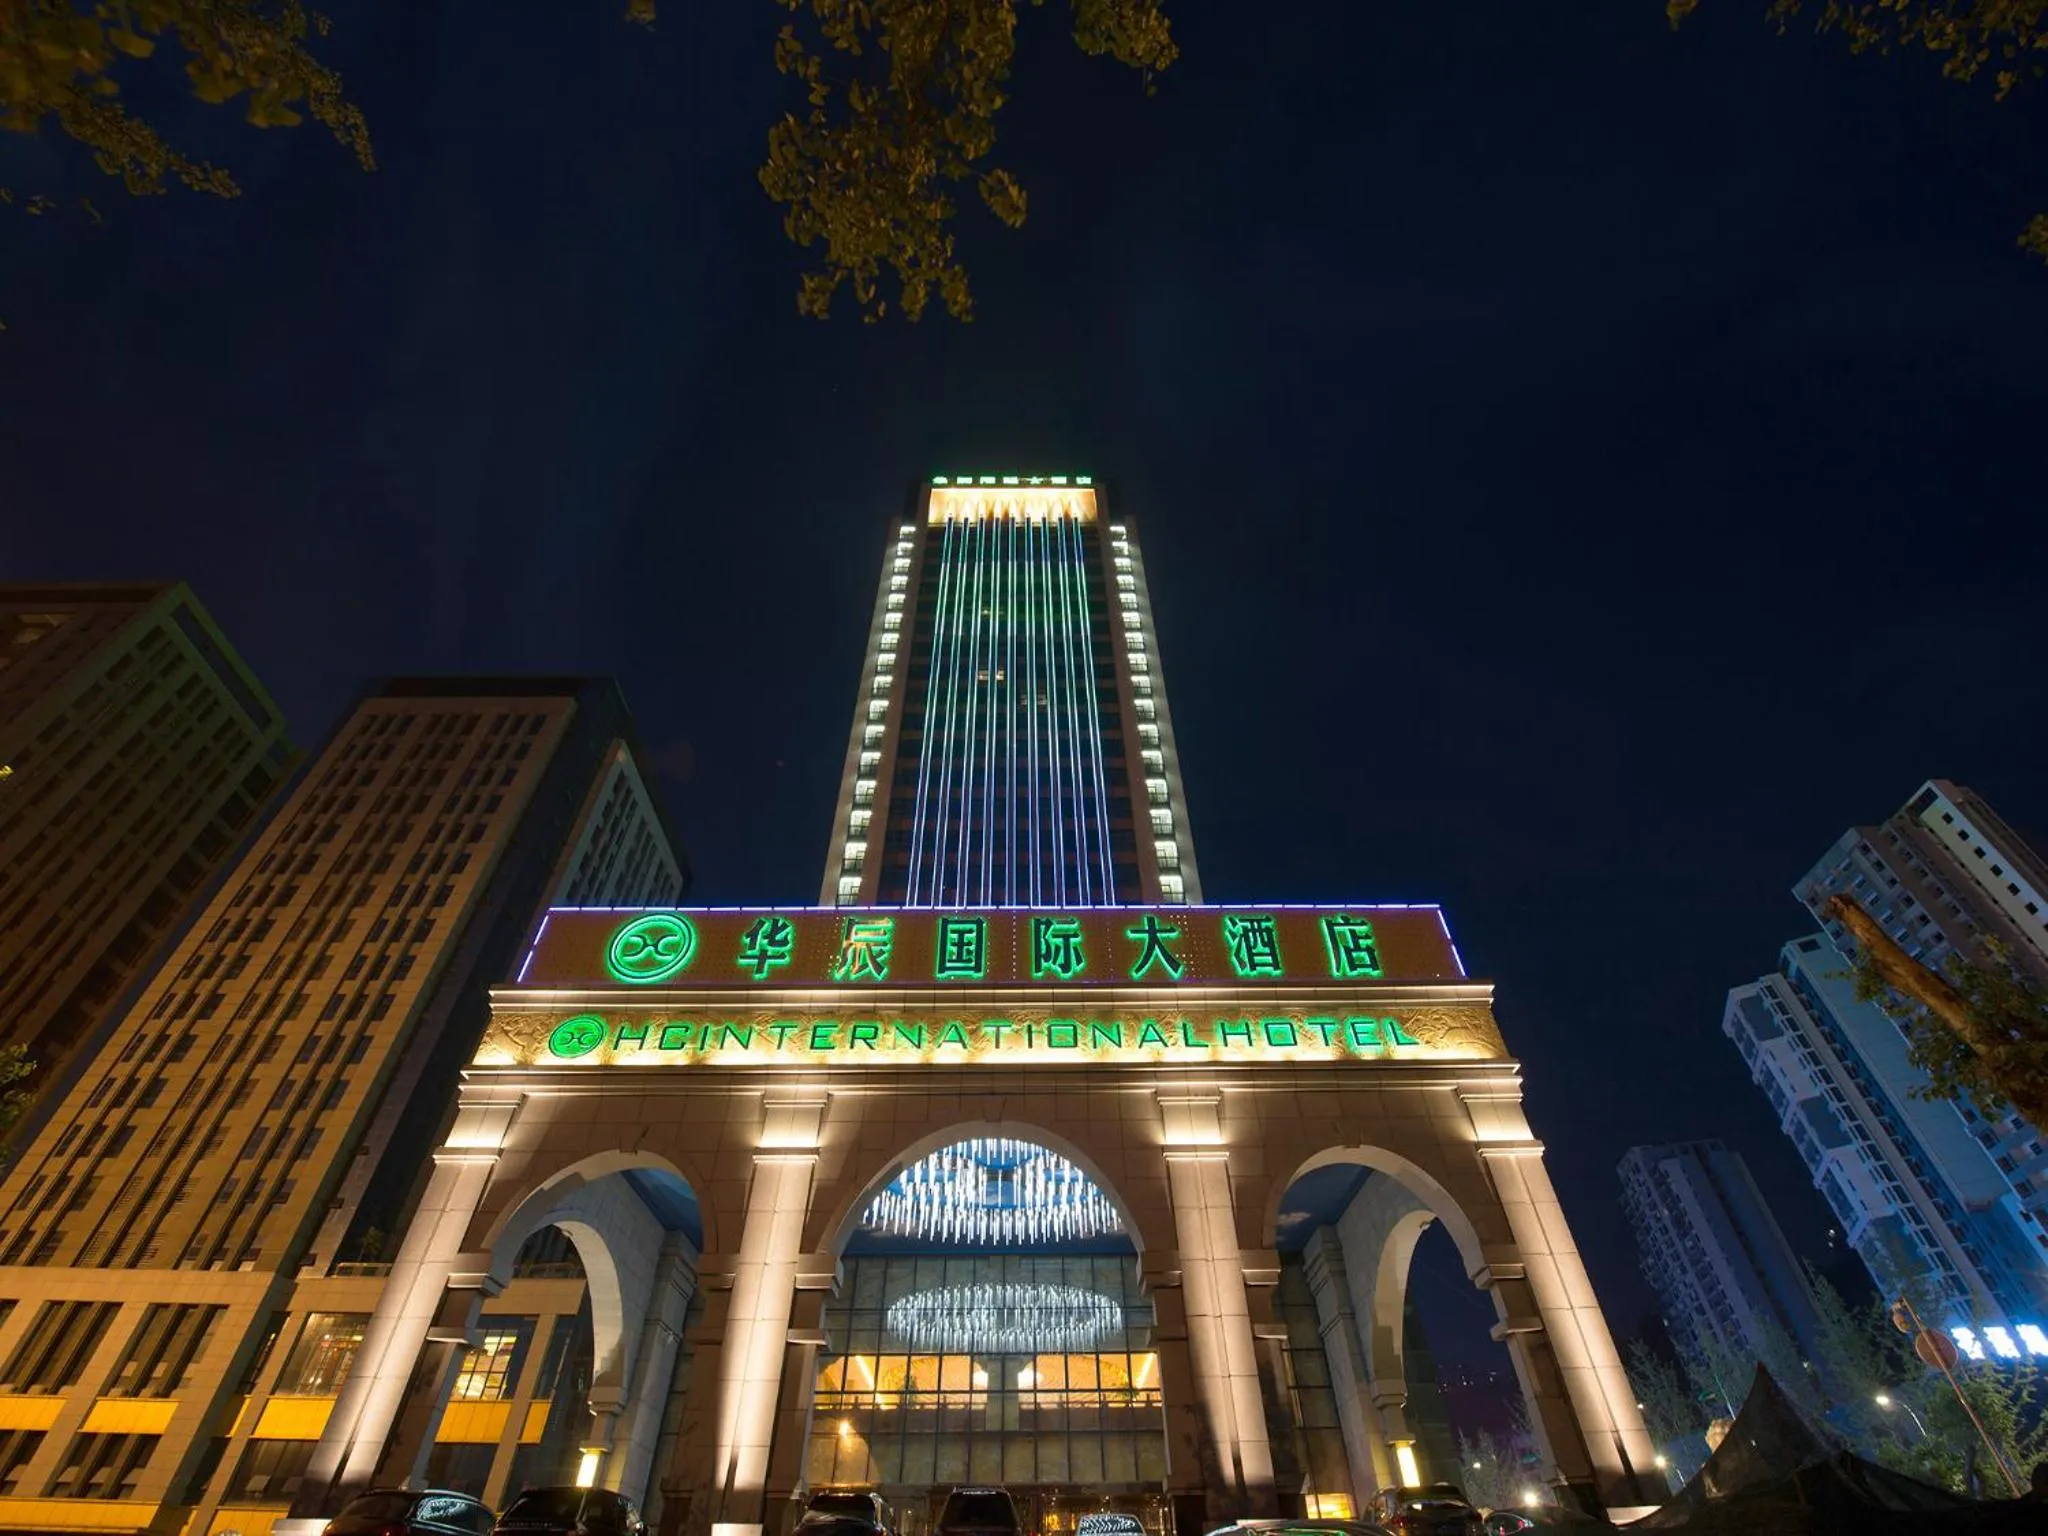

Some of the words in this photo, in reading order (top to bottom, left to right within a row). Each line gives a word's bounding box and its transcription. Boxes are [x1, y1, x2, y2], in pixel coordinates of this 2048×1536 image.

[737, 915, 1382, 979] 华辰国际大酒店
